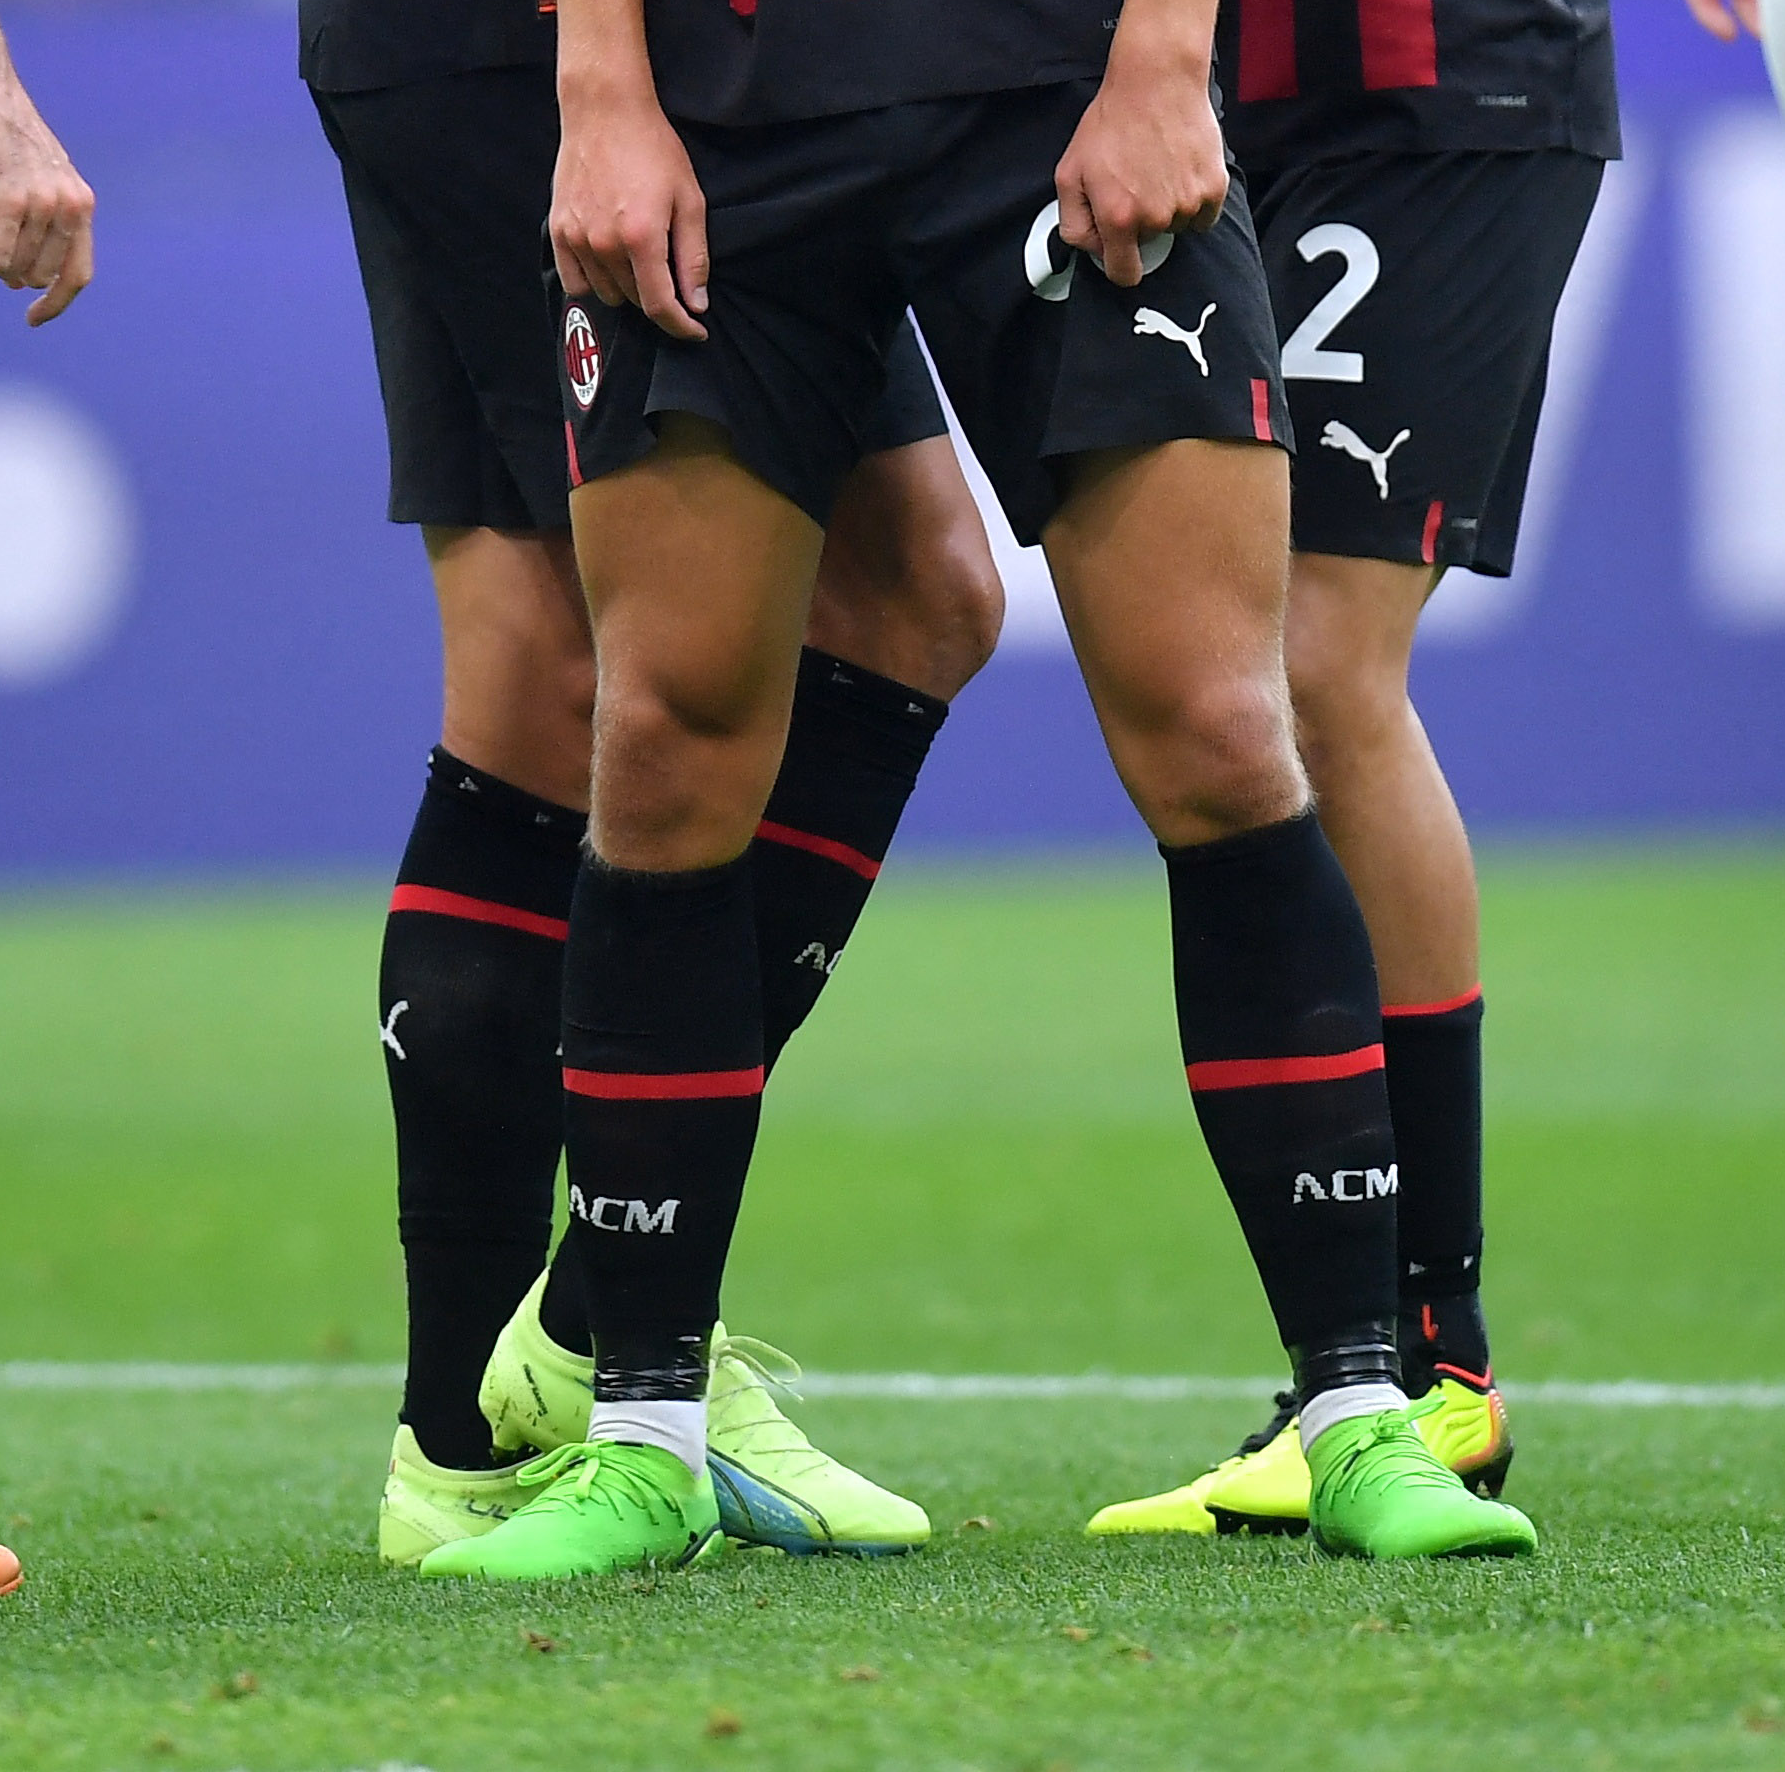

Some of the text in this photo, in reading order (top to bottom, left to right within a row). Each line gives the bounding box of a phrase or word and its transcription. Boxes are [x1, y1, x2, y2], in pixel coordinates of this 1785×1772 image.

[1281, 223, 1380, 383] 2
[570, 1184, 682, 1235] ACM
[1293, 1164, 1398, 1205] ACM
